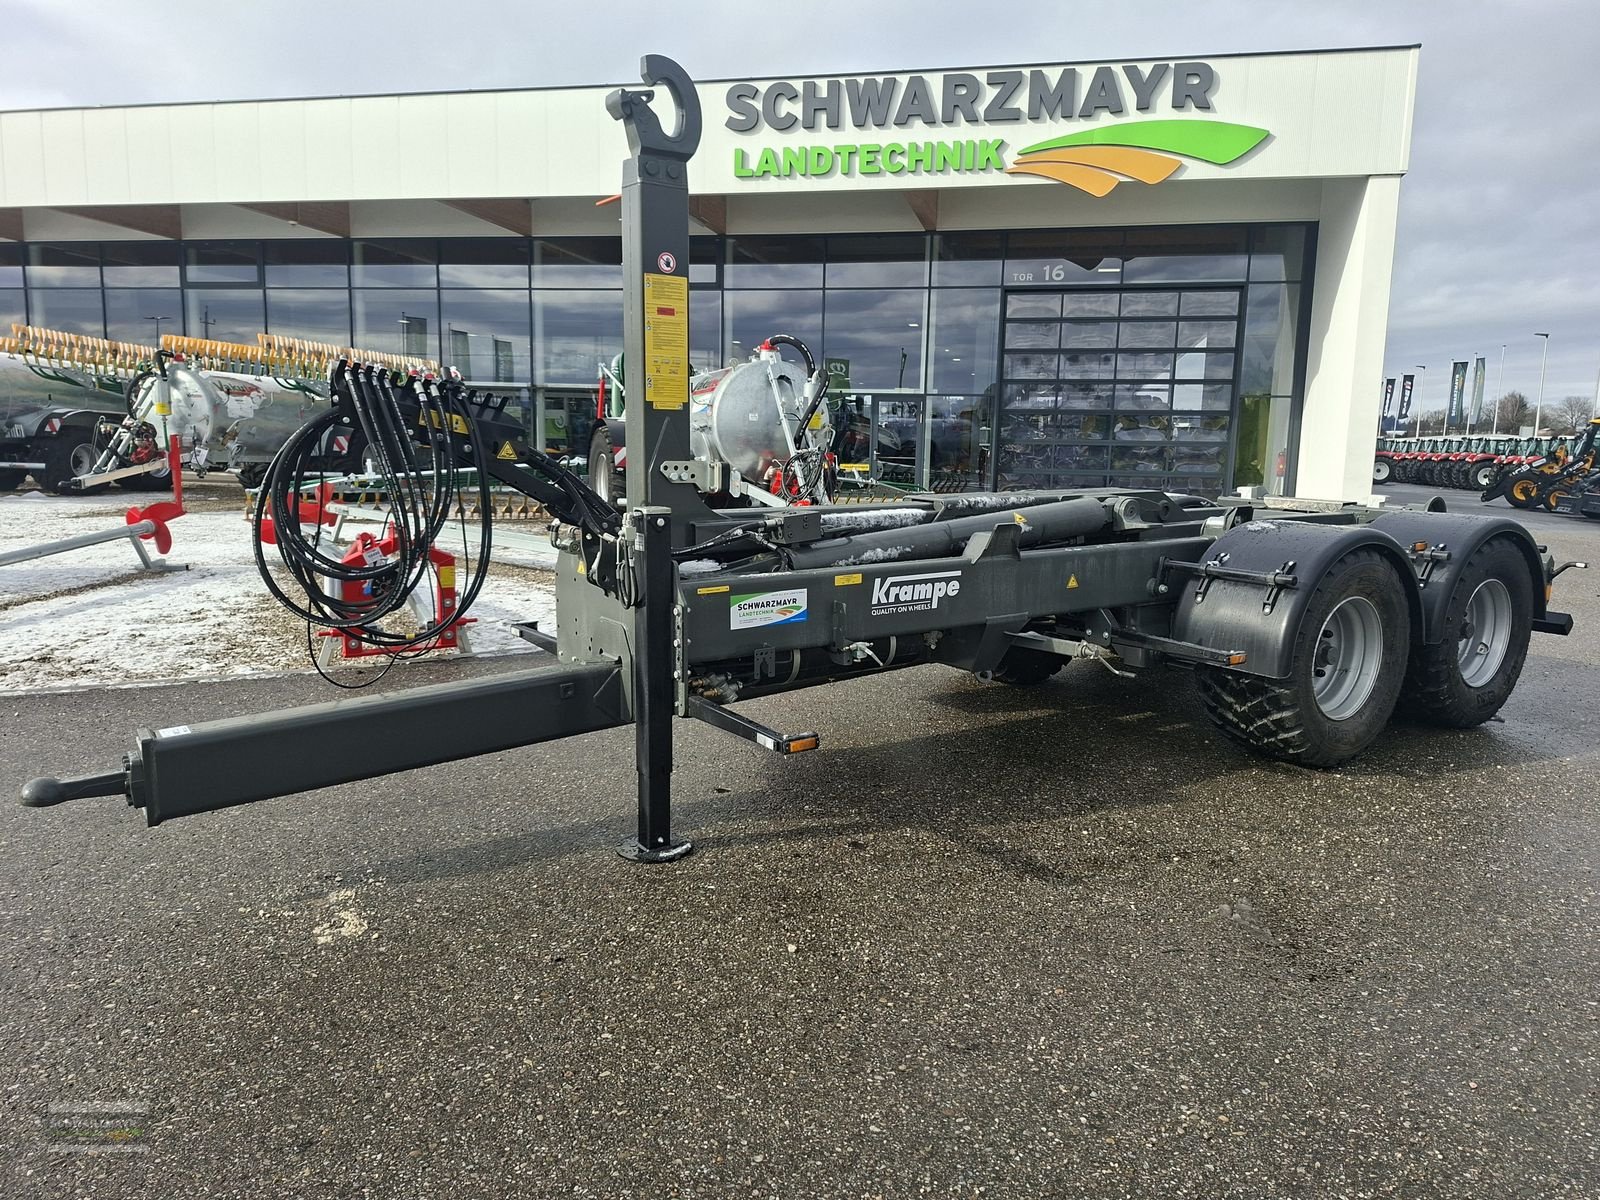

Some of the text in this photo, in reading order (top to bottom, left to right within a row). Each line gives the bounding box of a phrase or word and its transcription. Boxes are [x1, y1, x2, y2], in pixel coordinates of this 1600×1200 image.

[725, 61, 1215, 132] SCHWARZMAYR
[734, 139, 1004, 178] LANDTECHNIK
[1012, 264, 1065, 282] TOR 16
[871, 570, 962, 609] Krampe
[737, 597, 798, 611] SCHWARZMAYR
[871, 607, 897, 616] QUALITY
[738, 609, 774, 618] LANDTECHNIK
